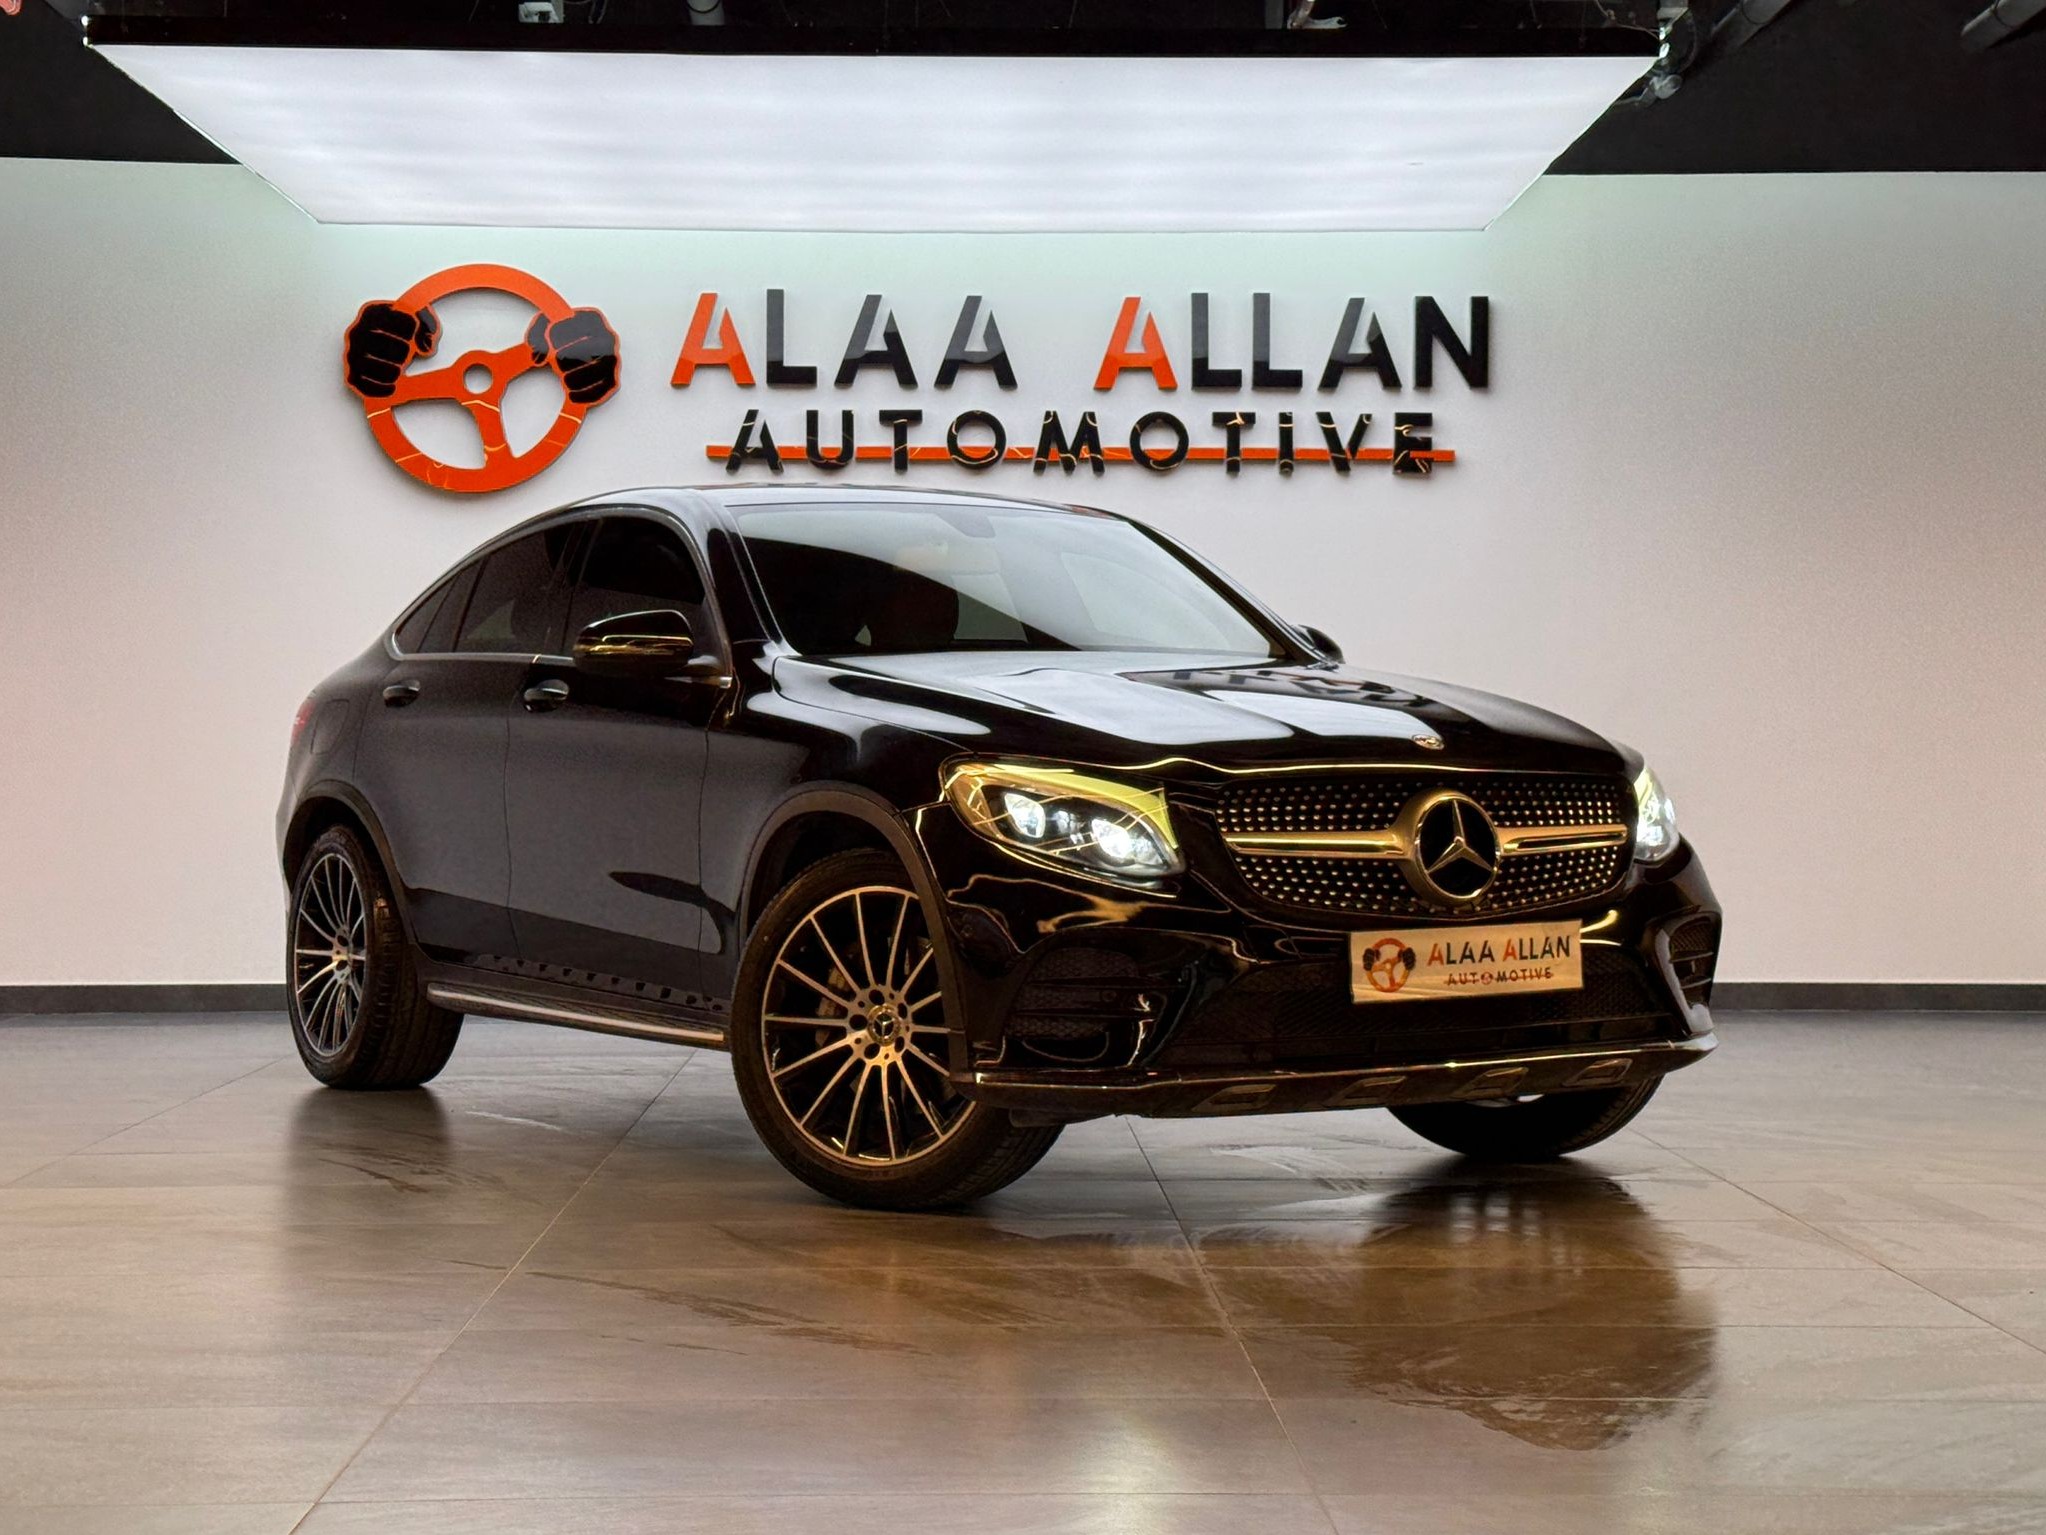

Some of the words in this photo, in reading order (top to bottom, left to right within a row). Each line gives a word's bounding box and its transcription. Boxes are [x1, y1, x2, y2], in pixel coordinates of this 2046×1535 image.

[671, 288, 1018, 388] ALAA
[1093, 291, 1489, 390] ALLAN
[726, 408, 1434, 474] AUTOMOTIVE
[1427, 940, 1495, 966] ALAA
[1502, 935, 1571, 961] ALLAN
[1447, 967, 1552, 985] AUTOMOTIVE
